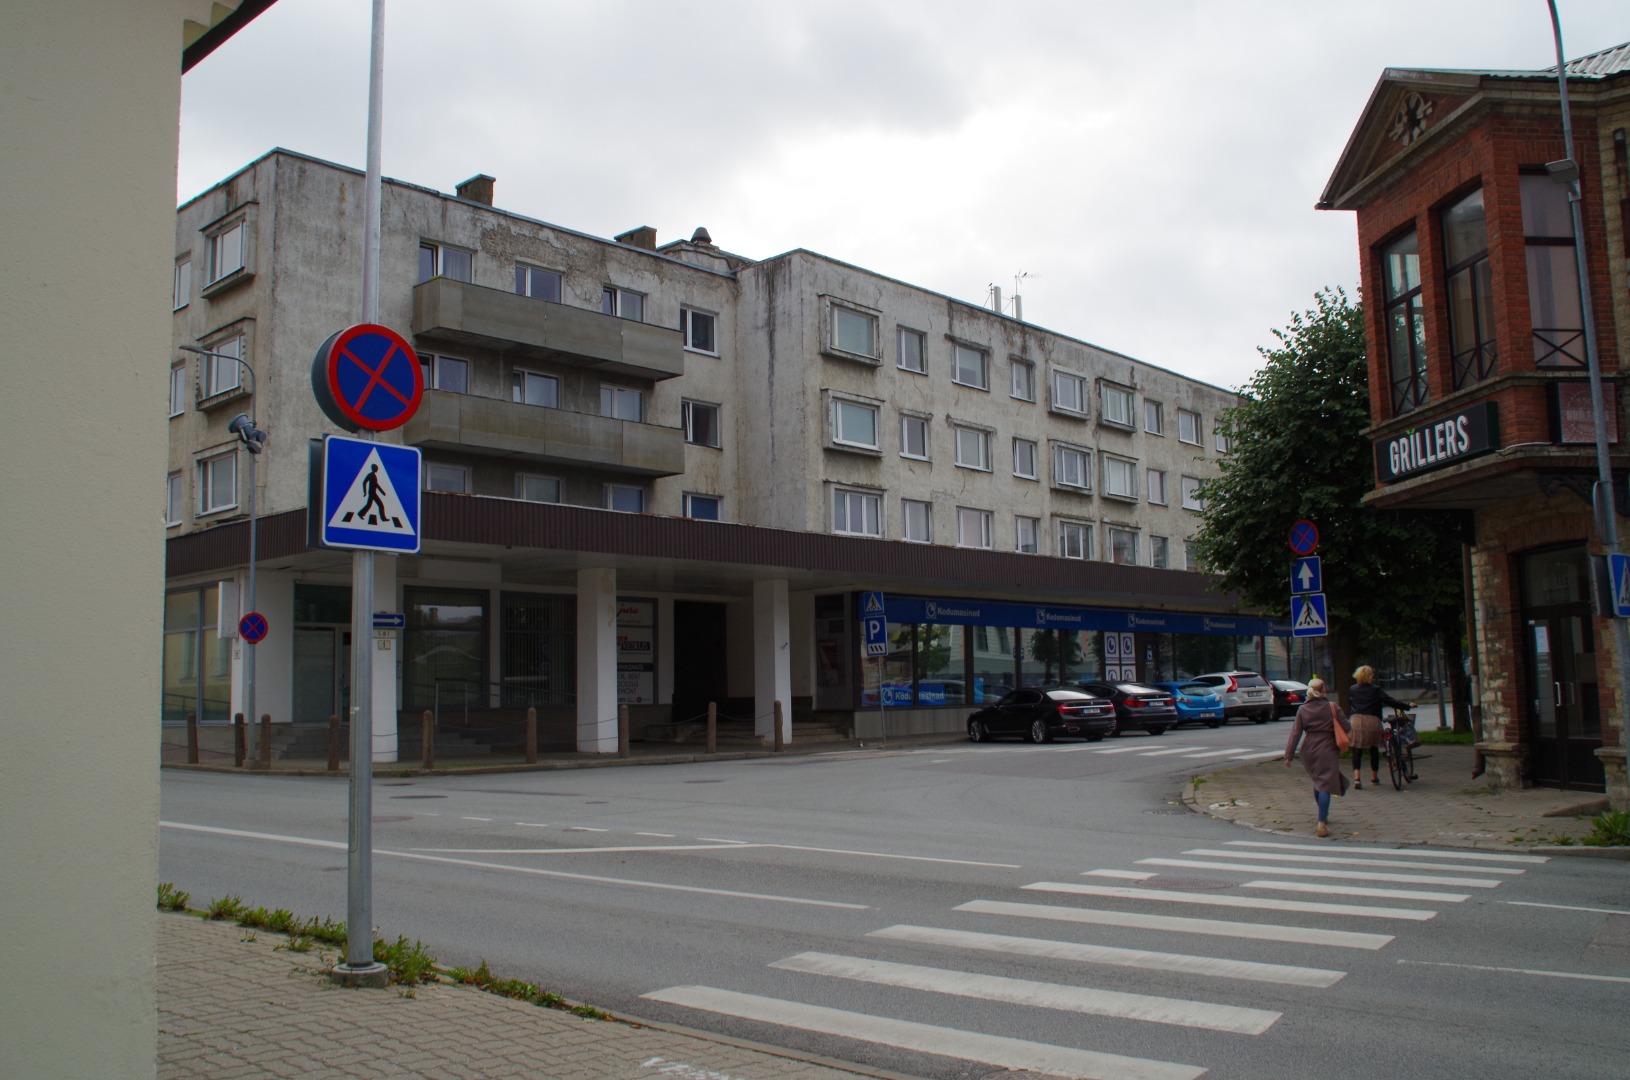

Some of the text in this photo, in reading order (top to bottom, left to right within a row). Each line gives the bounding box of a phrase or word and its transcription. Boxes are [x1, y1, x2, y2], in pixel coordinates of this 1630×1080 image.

[1390, 415, 1469, 475] GRILLERS
[937, 606, 980, 617] Kodumasinad
[1046, 614, 1082, 622] Kodumasinad
[870, 620, 880, 640] P
